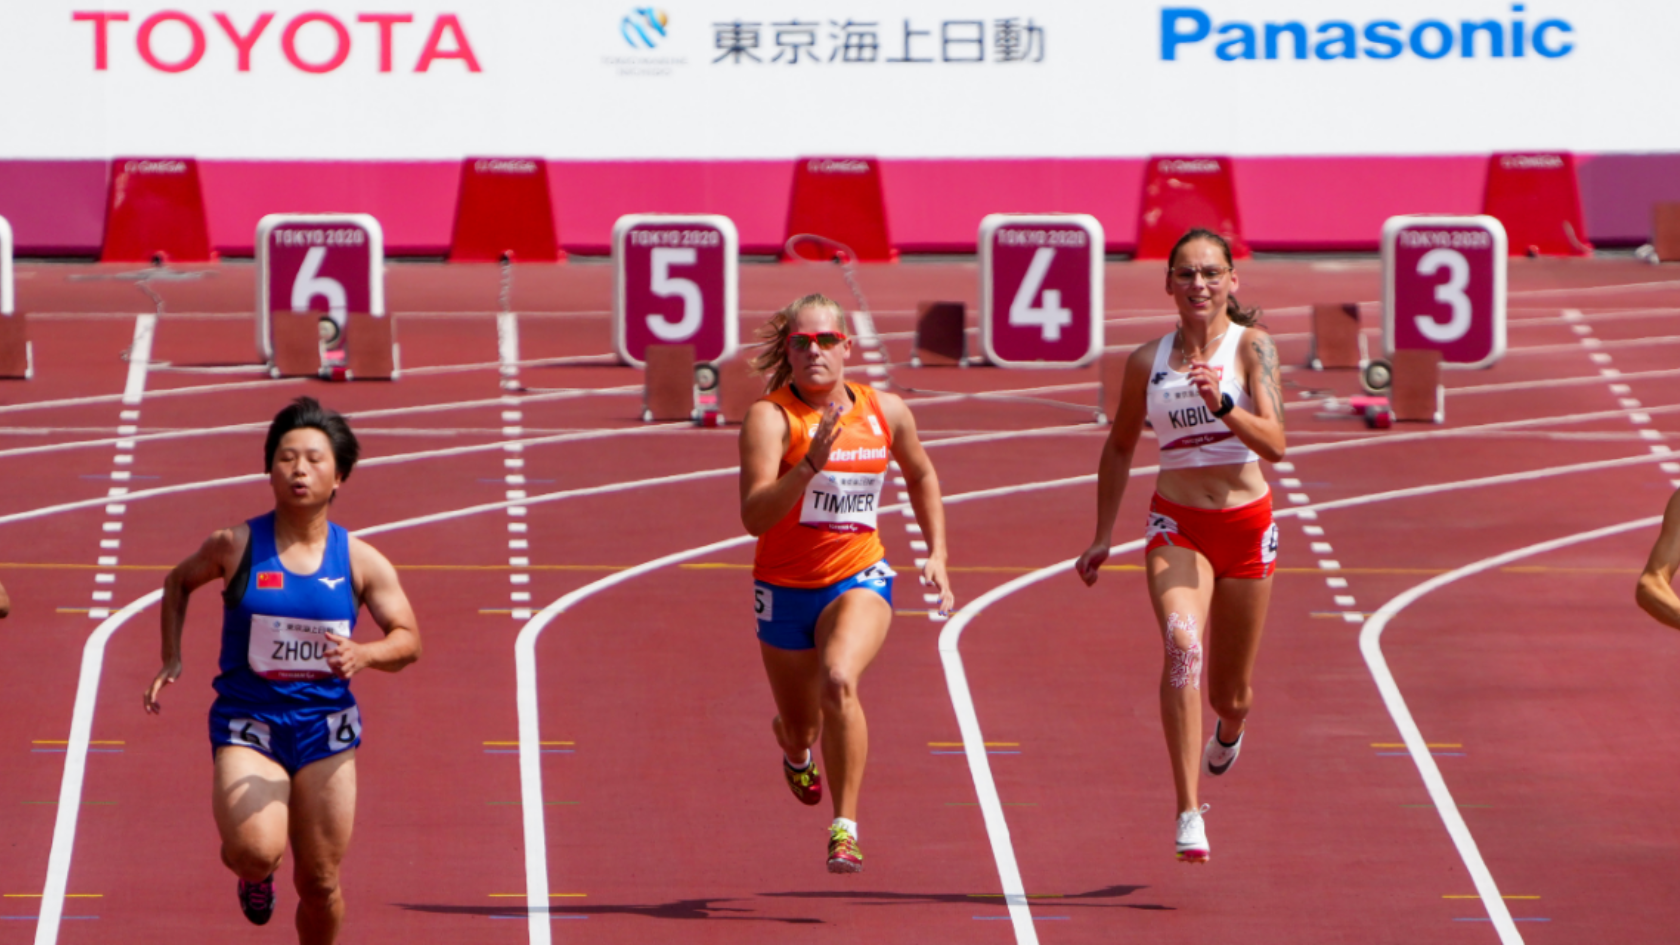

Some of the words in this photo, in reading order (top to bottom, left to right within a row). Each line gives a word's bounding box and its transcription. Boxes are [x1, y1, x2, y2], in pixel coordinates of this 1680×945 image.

[71, 9, 482, 74] TOYOTA
[711, 17, 1045, 65] 東京海上日動
[1159, 3, 1574, 61] Panasonic
[274, 228, 324, 247] TOKYO
[326, 228, 365, 247] 2020
[631, 229, 681, 247] TOKYO
[682, 229, 721, 247] 2020
[998, 228, 1047, 247] TOKYO
[1400, 229, 1451, 248] TOKYO
[290, 246, 348, 328] 6
[645, 247, 704, 342] 5
[1008, 246, 1073, 342] 4
[1413, 247, 1473, 343] 3
[1168, 405, 1216, 429] KIBIL
[829, 446, 886, 462] derland
[813, 489, 874, 514] TIMMER
[754, 588, 765, 614] 5
[271, 640, 328, 661] ZHOU
[336, 713, 356, 743] 6
